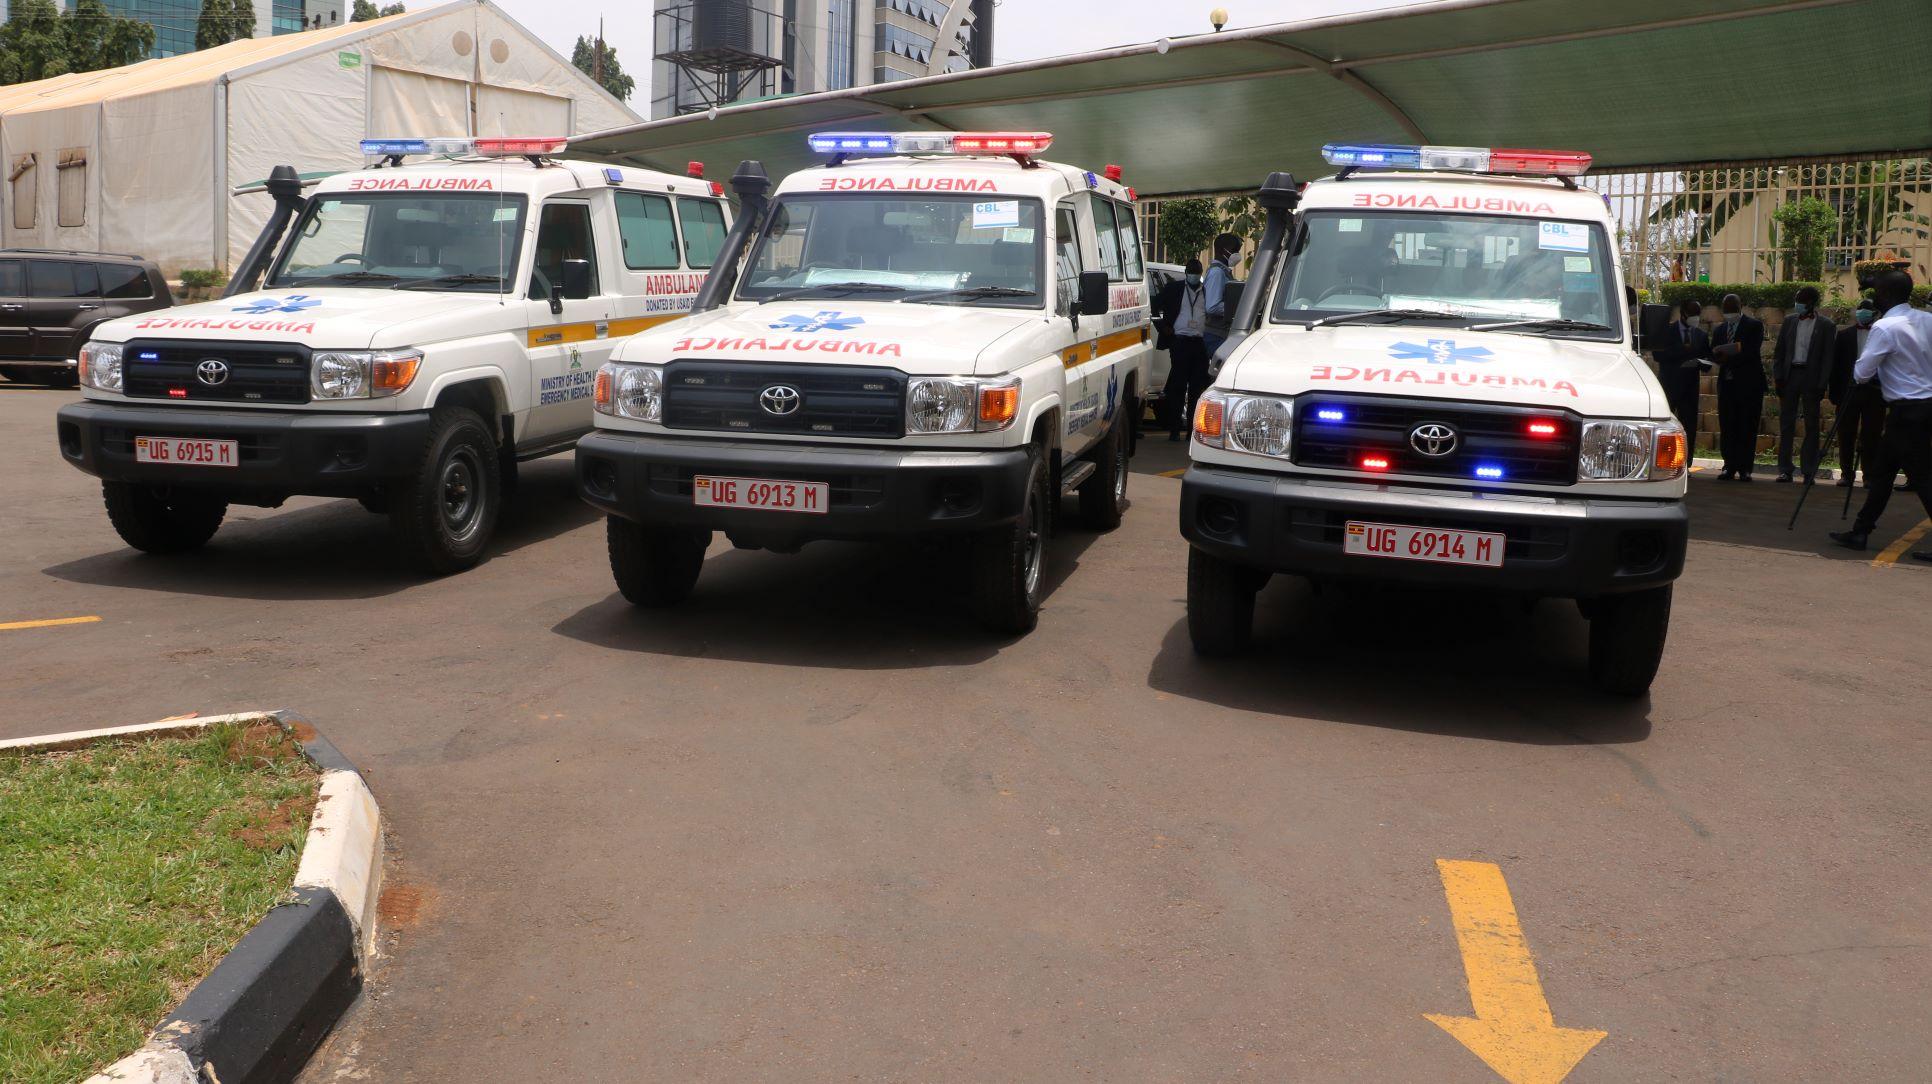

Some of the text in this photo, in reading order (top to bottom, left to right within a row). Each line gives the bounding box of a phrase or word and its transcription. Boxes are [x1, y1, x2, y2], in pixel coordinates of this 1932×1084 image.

[975, 203, 1001, 213] CBL
[1542, 223, 1569, 235] CBL
[645, 298, 669, 312] DONATED
[669, 298, 676, 311] BY
[541, 375, 565, 391] MINISTRY
[565, 374, 573, 387] OF
[573, 370, 592, 386] HEALTH
[540, 389, 570, 405] EMERGENCY
[570, 385, 590, 400] MEDICAL
[149, 441, 230, 463] UG 6915 M
[711, 481, 817, 509] UG 6913 M
[1366, 527, 1492, 561] UG 6914 M
